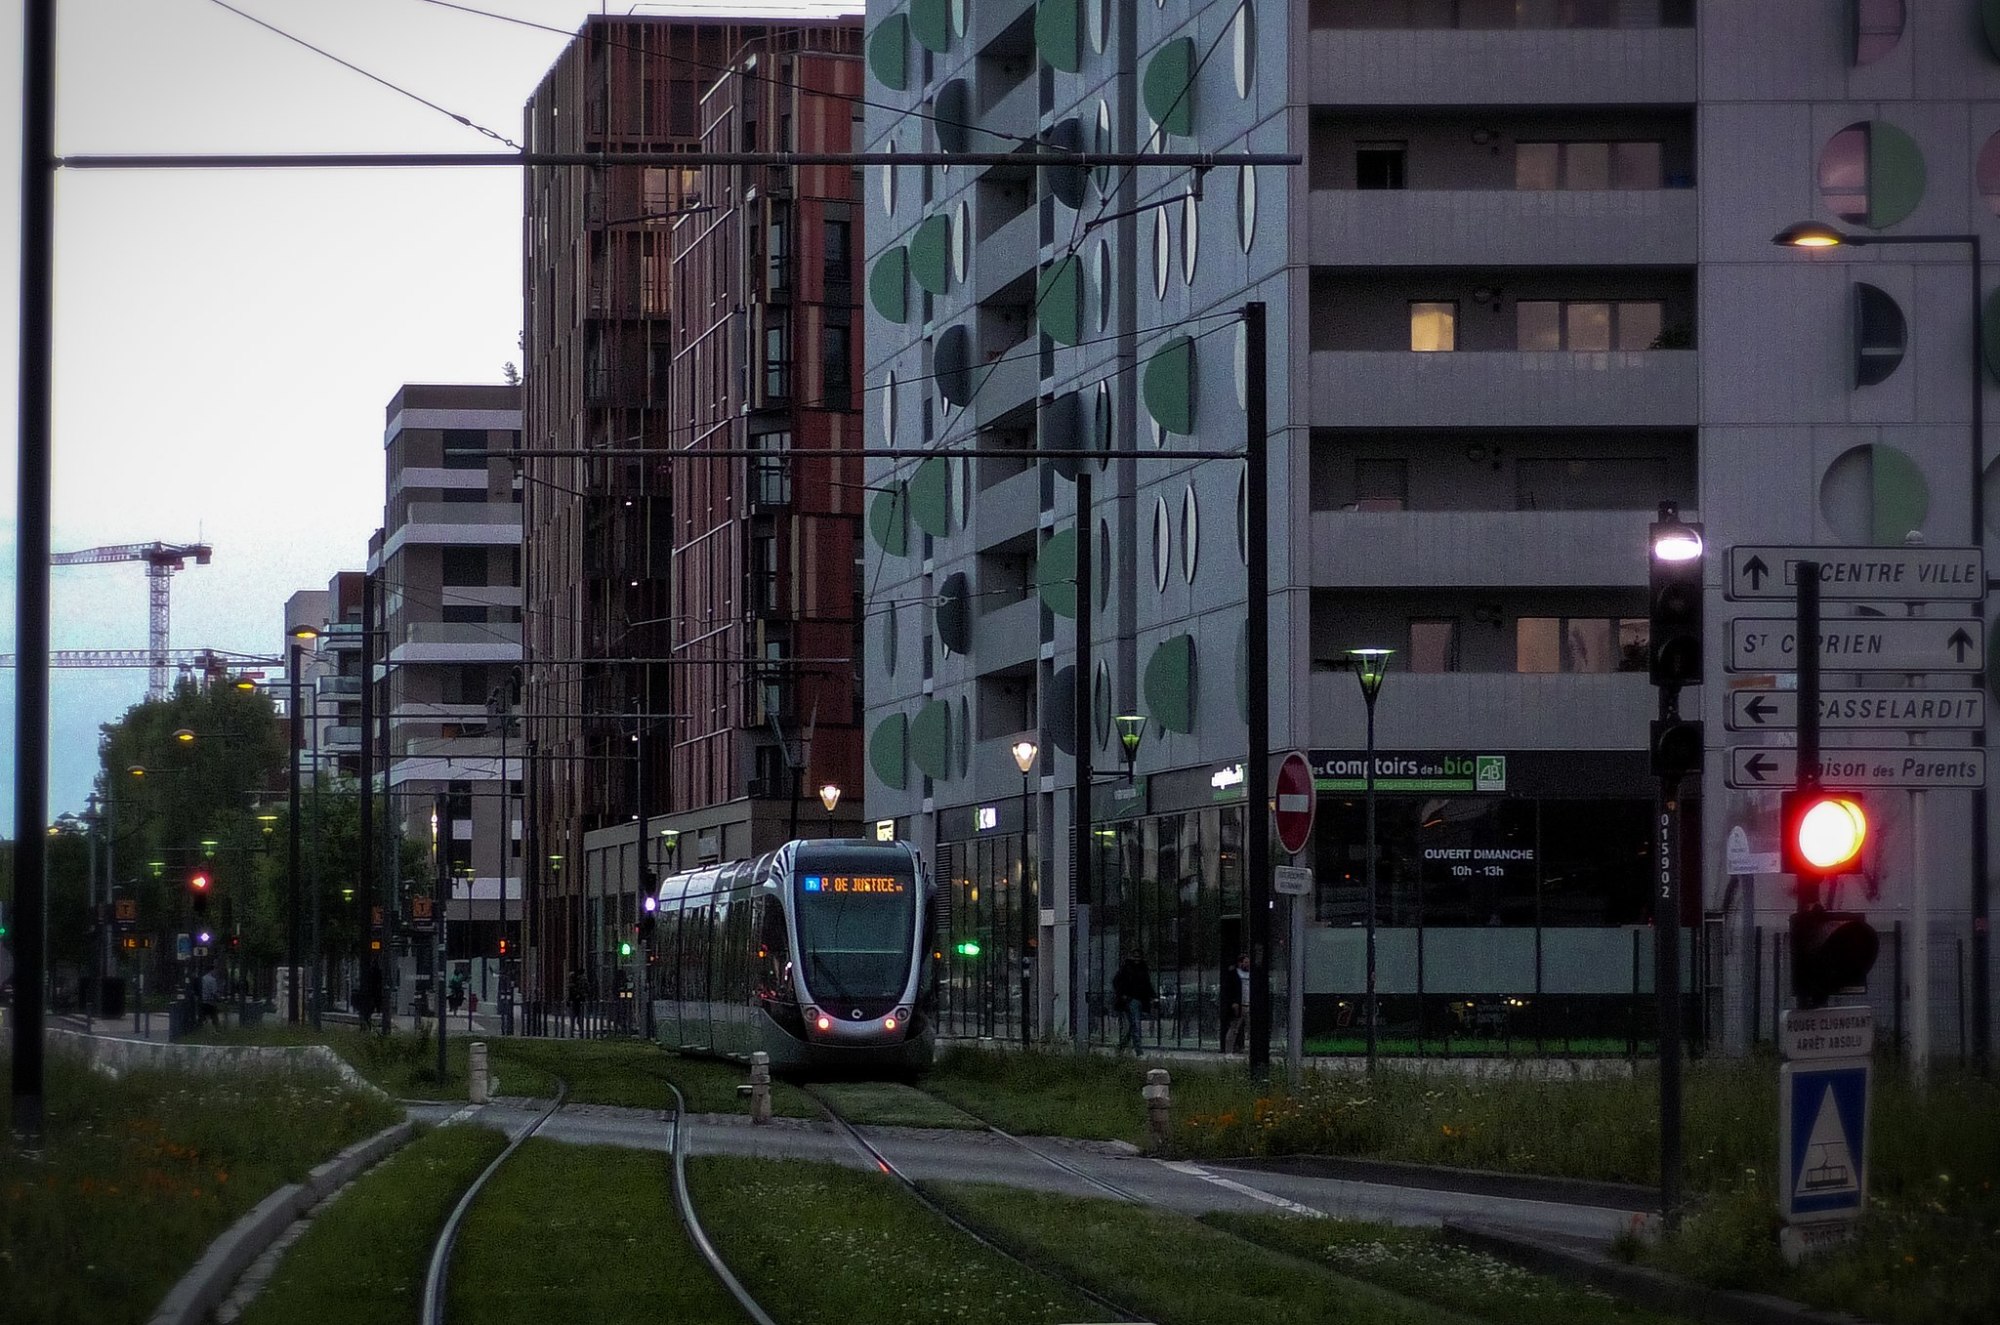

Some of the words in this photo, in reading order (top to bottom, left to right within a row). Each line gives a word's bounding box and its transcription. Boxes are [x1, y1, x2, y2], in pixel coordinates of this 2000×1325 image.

[1819, 563, 1905, 583] CENTRE
[1918, 564, 1976, 584] VILLE
[1781, 634, 1882, 654] CRIEN
[1443, 756, 1474, 775] bio
[1817, 757, 1867, 777] ison
[1872, 763, 1895, 777] des
[1902, 757, 1977, 778] Parents
[1424, 848, 1472, 860] OUVERT
[1472, 848, 1534, 860] DIMANCHE
[1450, 865, 1472, 876] 10h
[1482, 865, 1505, 876] 13h
[851, 877, 895, 892] JUSTICE
[1786, 1017, 1817, 1033] ROUGE
[1828, 1035, 1863, 1050] ABSOLU
